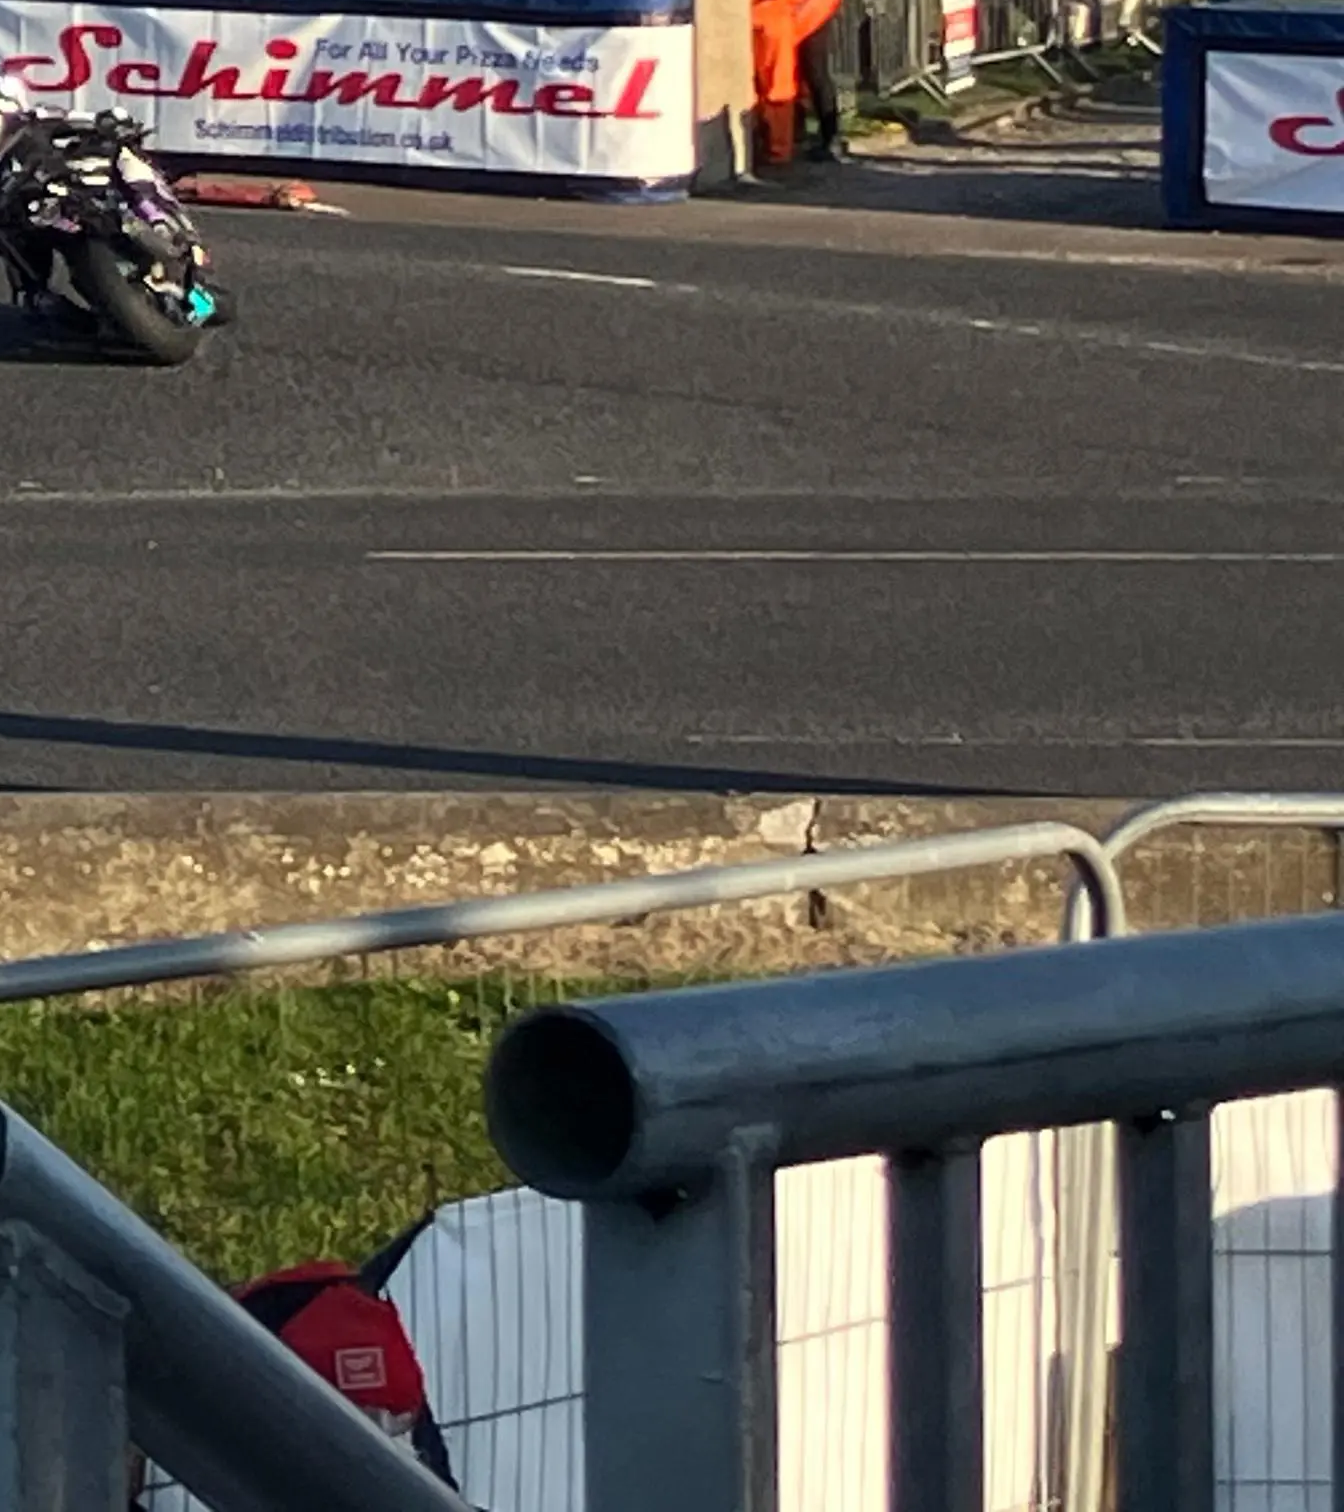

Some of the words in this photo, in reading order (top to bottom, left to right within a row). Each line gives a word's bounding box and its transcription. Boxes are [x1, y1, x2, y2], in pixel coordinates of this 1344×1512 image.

[0, 24, 662, 121] Schimmel
[315, 38, 352, 61] For
[358, 40, 388, 61] All
[396, 42, 449, 66] Your
